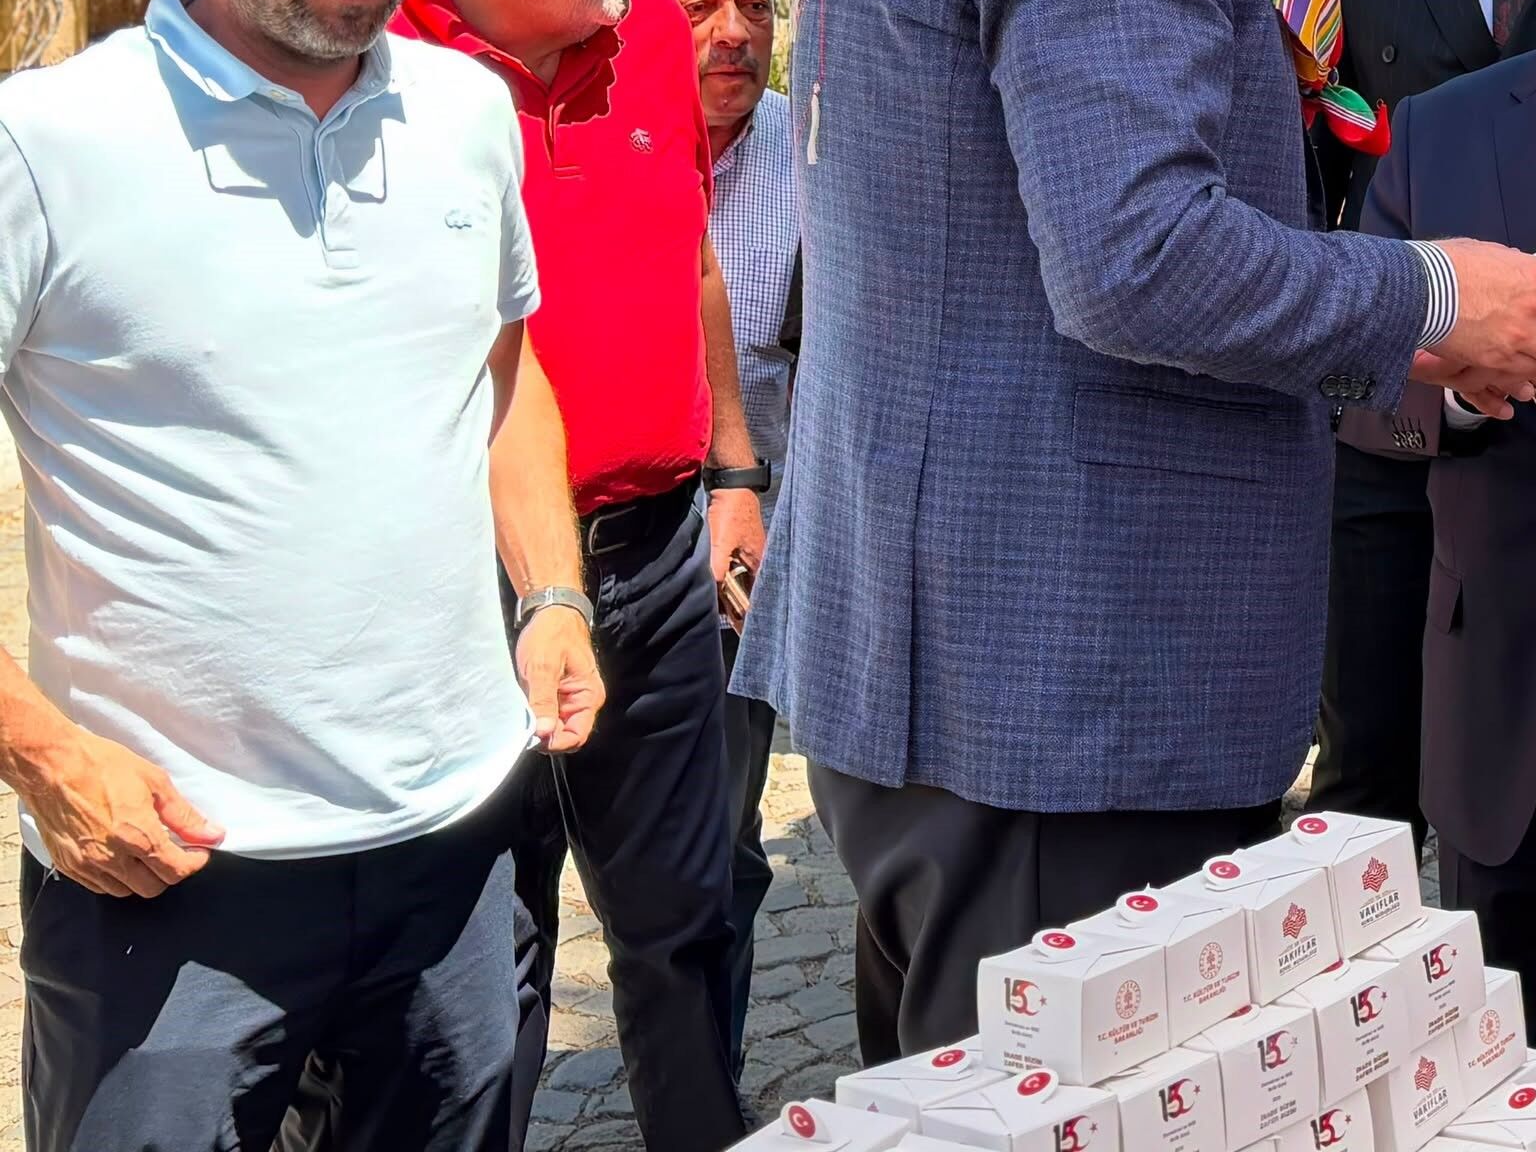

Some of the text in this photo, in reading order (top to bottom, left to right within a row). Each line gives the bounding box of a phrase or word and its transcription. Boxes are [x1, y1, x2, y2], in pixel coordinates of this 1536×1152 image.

[1359, 891, 1400, 920] VAKIFLAR
[1278, 937, 1318, 967] VAKIFLAR
[1004, 977, 1038, 1016] 15
[1412, 1089, 1448, 1120] VAKIFLAR
